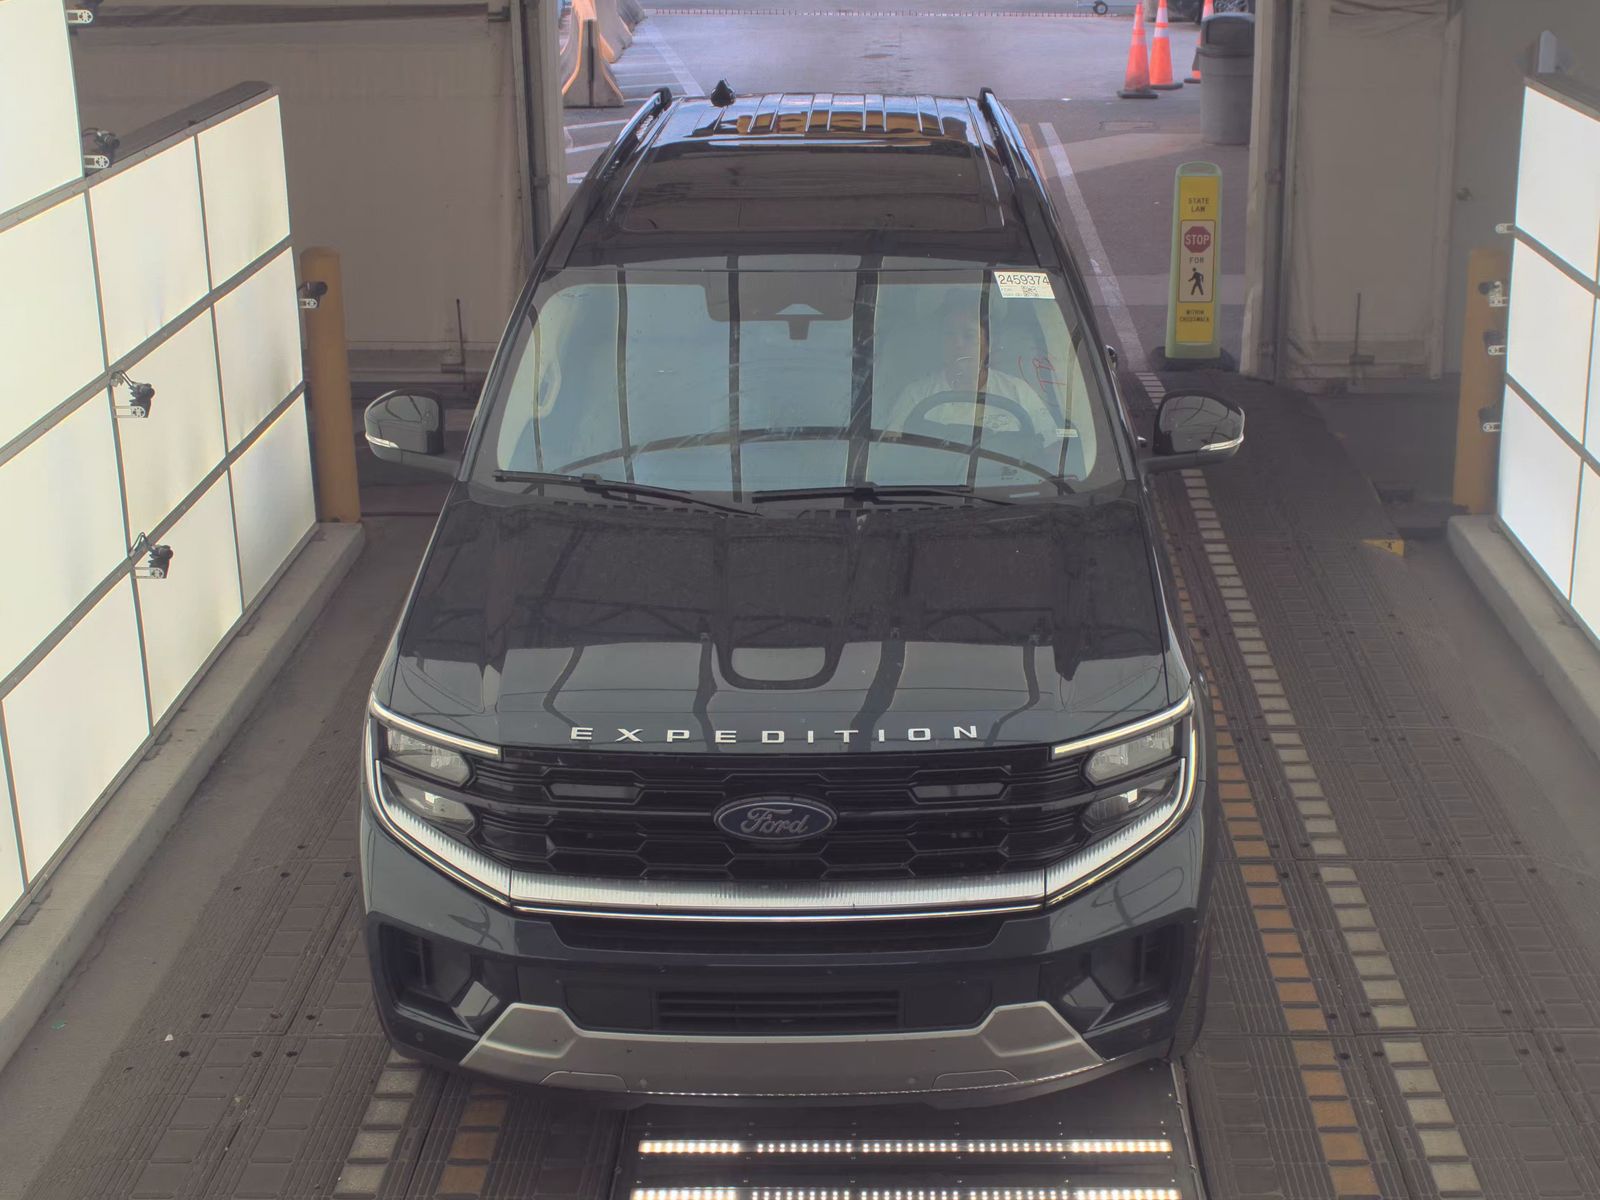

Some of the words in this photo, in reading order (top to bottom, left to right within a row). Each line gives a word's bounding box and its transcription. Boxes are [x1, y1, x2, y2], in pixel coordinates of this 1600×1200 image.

[1188, 197, 1209, 205] STATE
[1185, 234, 1210, 246] STOP
[1189, 256, 1205, 264] FOR
[998, 274, 1050, 285] 2459374
[570, 725, 978, 744] EXPEDITION
[740, 807, 811, 834] Ford
